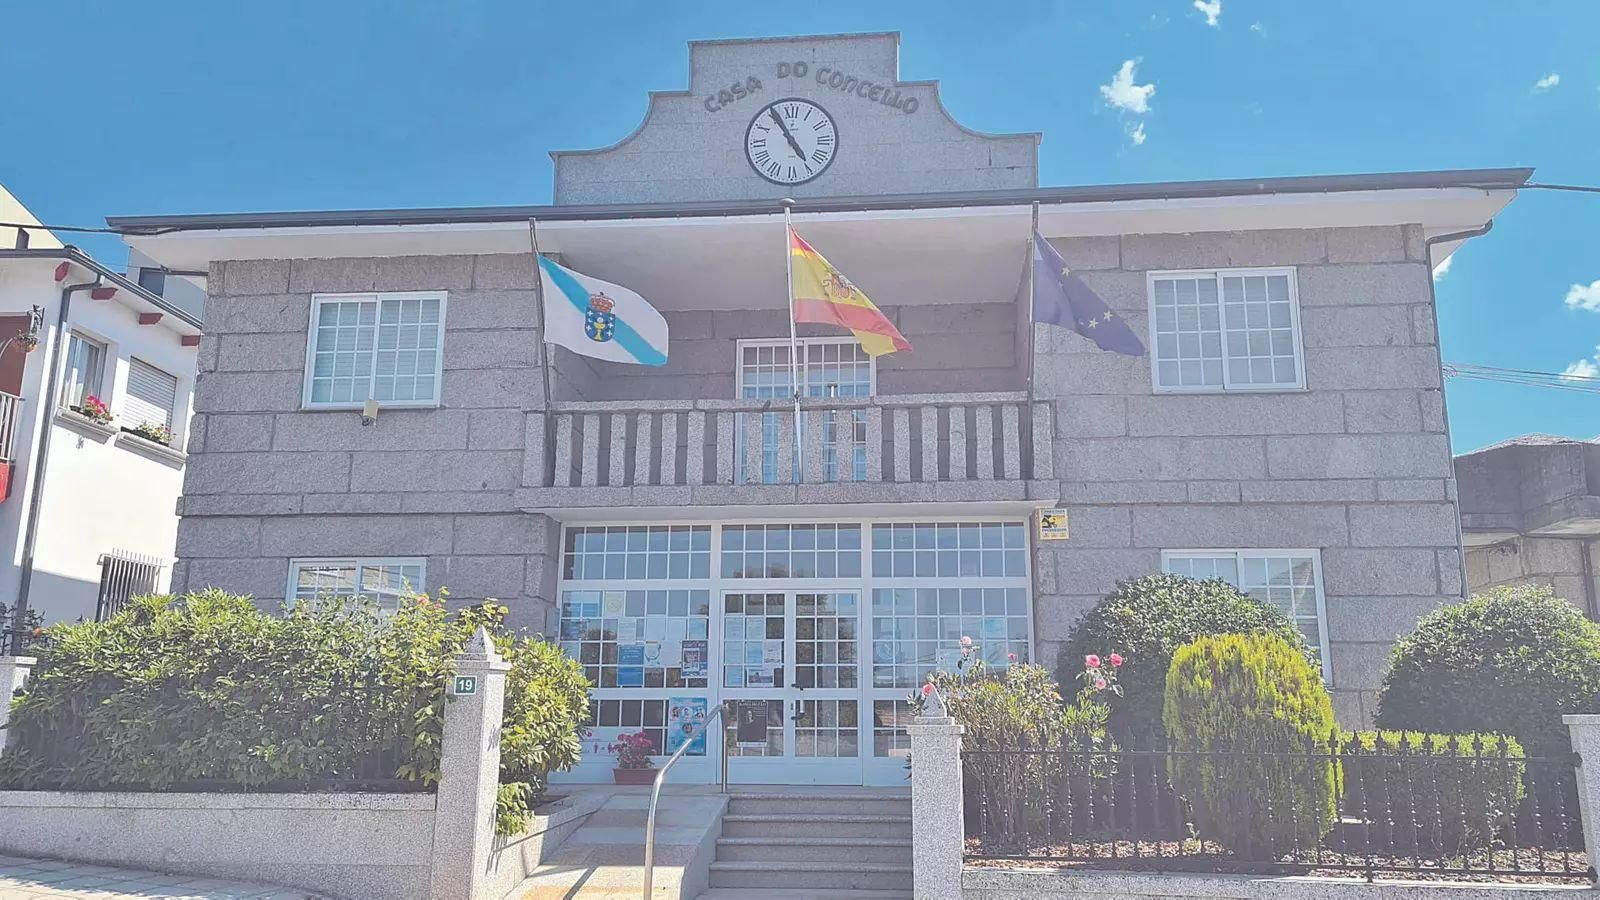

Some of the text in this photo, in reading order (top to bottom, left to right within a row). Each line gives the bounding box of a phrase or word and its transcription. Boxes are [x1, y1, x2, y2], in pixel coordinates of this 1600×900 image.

[704, 61, 920, 114] CASA DO CONCELLO
[784, 106, 799, 119] XII
[813, 120, 827, 131] II
[817, 135, 830, 145] III
[767, 161, 781, 177] VII
[788, 166, 797, 178] VI
[459, 680, 472, 691] 19
